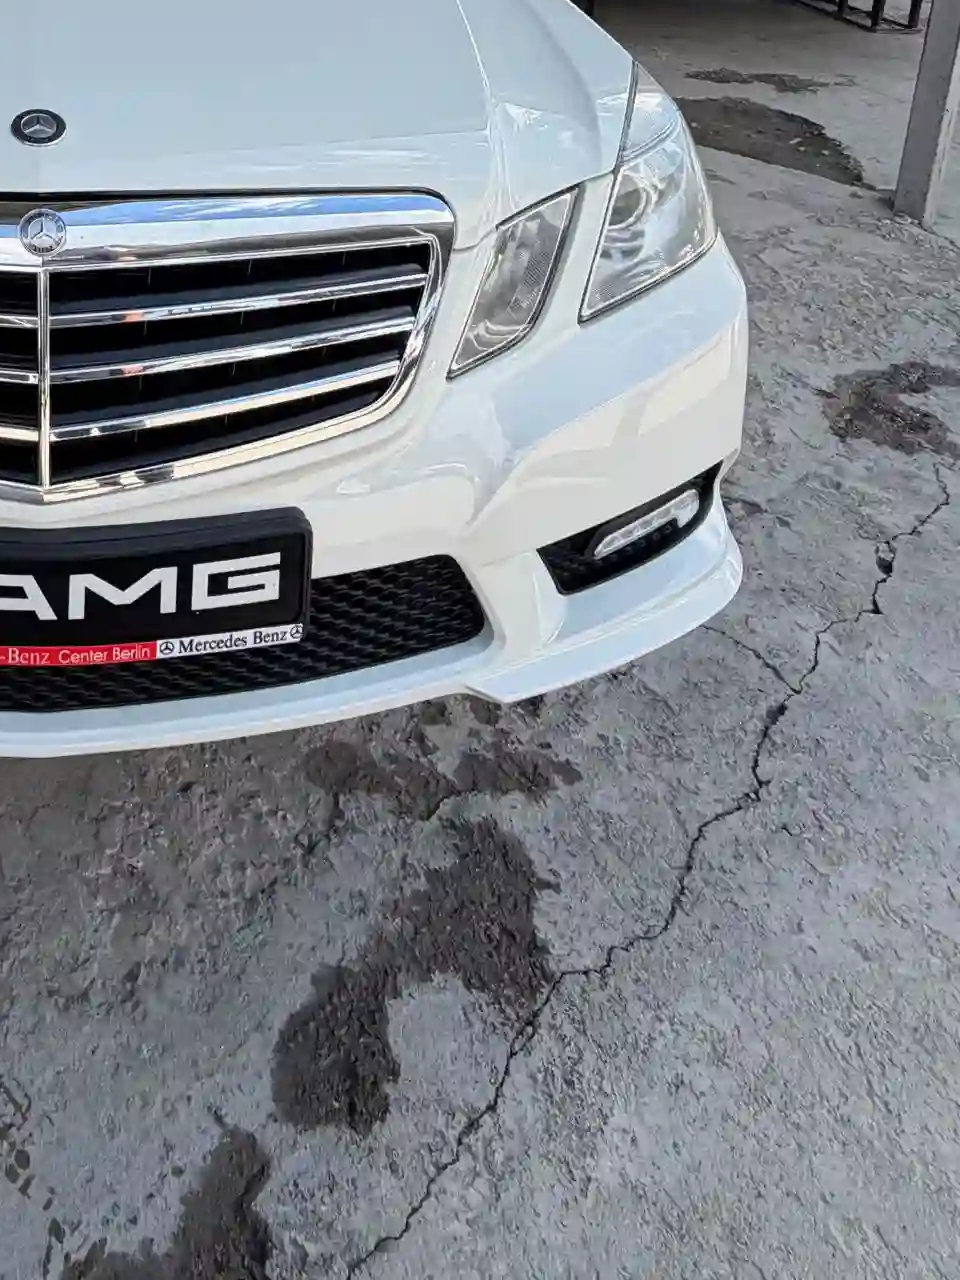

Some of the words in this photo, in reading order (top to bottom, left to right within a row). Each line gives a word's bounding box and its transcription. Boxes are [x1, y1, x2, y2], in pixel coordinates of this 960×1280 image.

[178, 634, 248, 654] Mercedes
[253, 628, 288, 646] Benz
[58, 647, 107, 664] Center
[112, 643, 151, 661] Berlin
